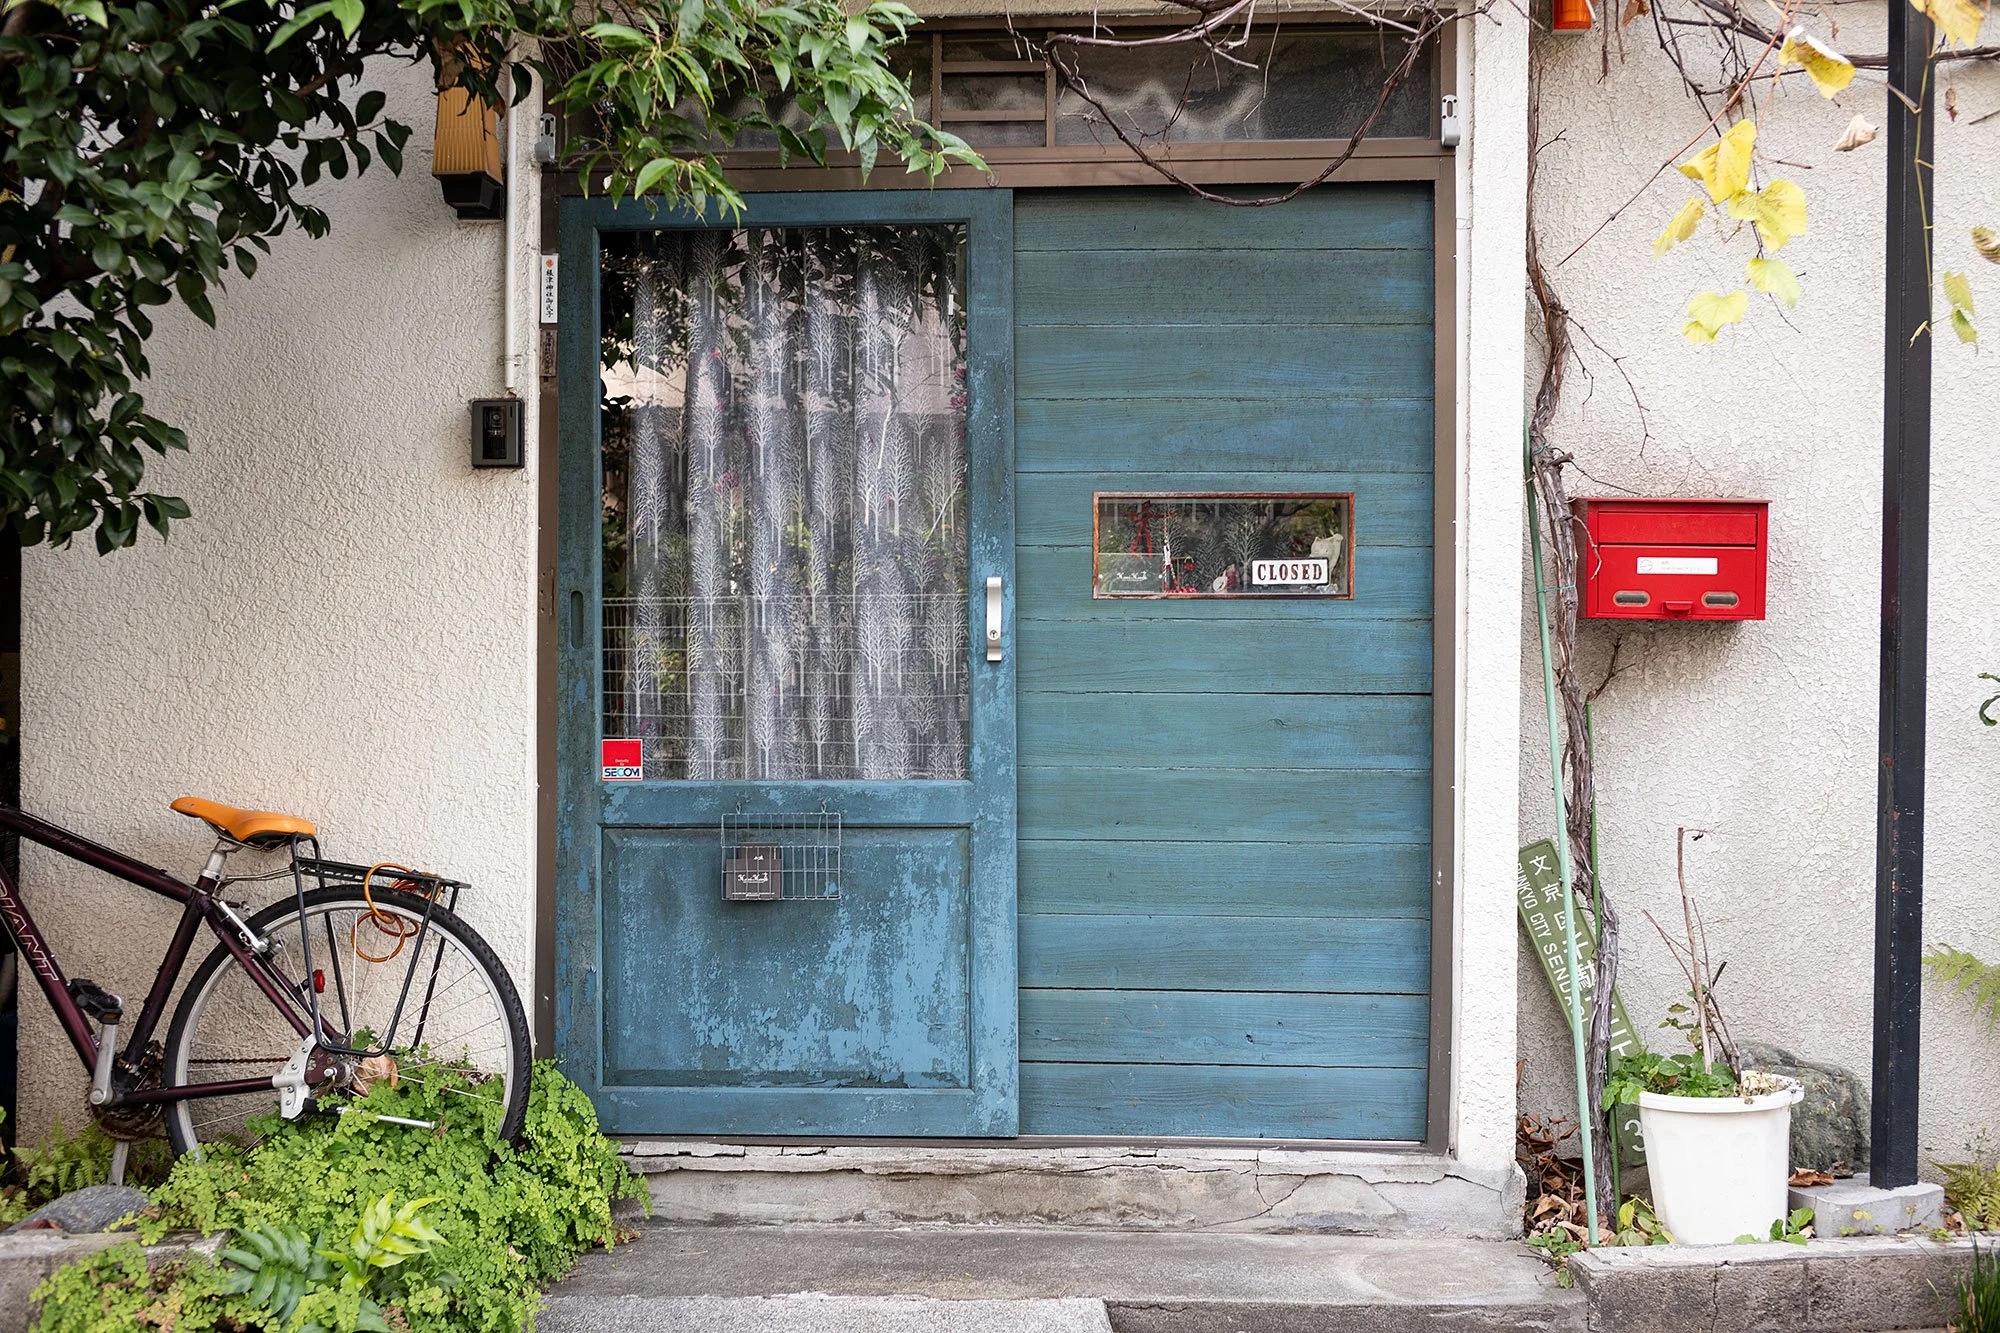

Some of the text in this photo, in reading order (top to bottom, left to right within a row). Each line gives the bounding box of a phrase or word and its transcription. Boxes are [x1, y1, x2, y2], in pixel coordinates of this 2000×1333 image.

[1257, 563, 1322, 581] CLOSED
[604, 767, 640, 777] SECOM
[0, 878, 59, 981] IANT
[1530, 912, 1552, 938] CITY
